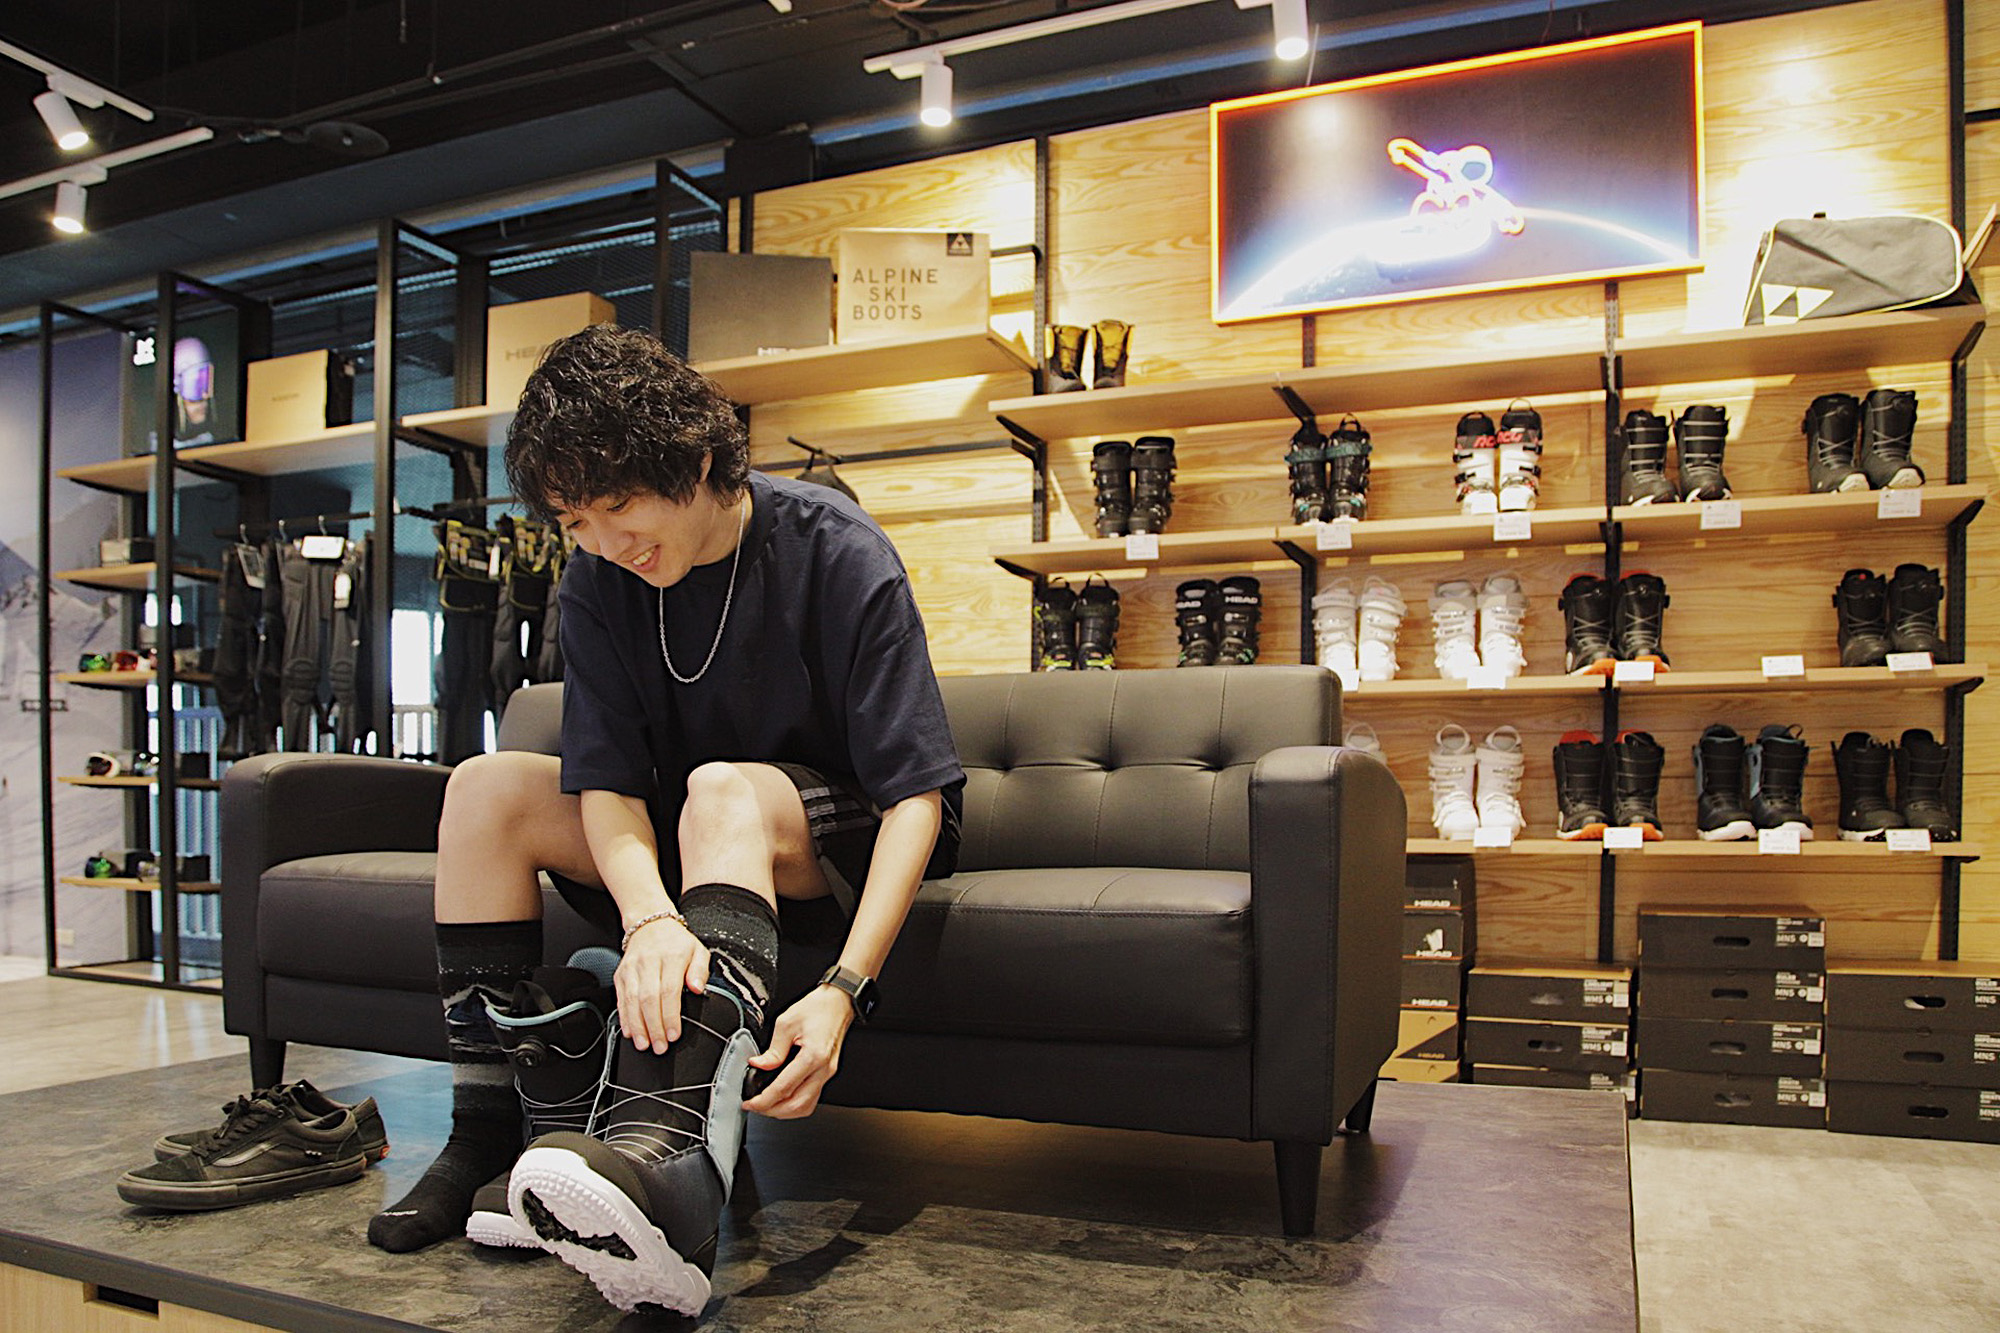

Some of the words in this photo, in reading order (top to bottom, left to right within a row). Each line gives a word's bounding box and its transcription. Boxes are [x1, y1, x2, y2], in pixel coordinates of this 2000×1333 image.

[852, 268, 939, 284] ALPINE
[869, 286, 906, 302] SKI
[852, 305, 922, 321] BOOTS
[1224, 595, 1259, 605] HEAD
[1414, 899, 1451, 908] HEAD
[1776, 934, 1797, 943] MNS
[1415, 949, 1453, 958] HEAD
[1775, 988, 1796, 998] MNS
[1411, 998, 1449, 1007] HEAD
[1975, 995, 1997, 1005] MNS
[1772, 1041, 1793, 1050] MNS
[1973, 1051, 1996, 1062] MNS
